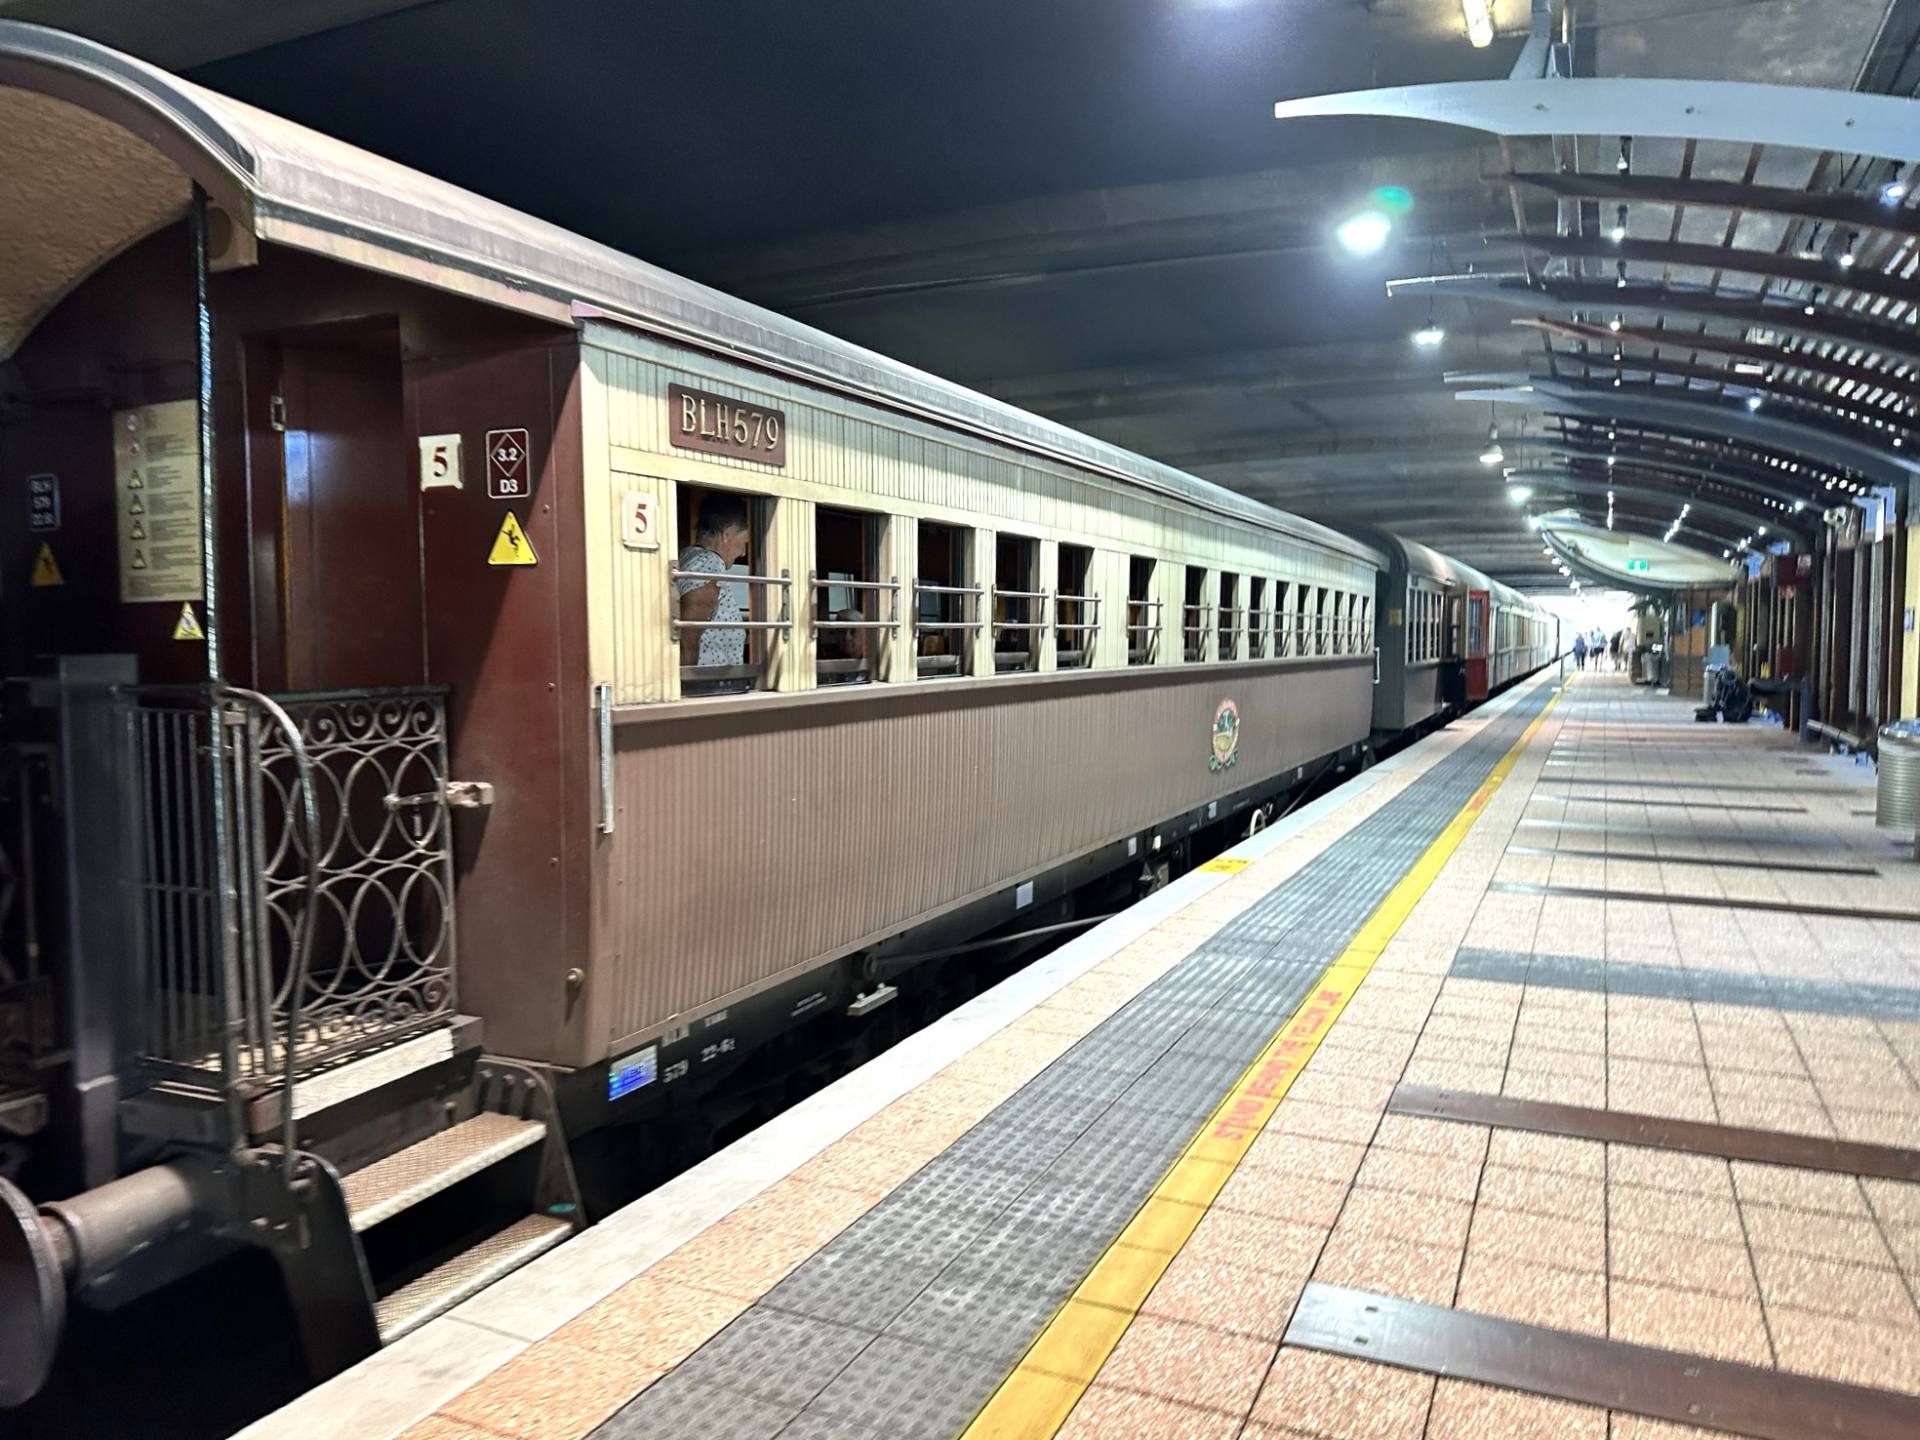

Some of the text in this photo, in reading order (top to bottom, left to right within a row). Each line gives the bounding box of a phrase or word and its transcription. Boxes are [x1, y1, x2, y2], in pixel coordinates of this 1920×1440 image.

[680, 393, 779, 450] BLH579
[433, 446, 448, 477] 5
[498, 447, 518, 462] 3.2
[500, 479, 519, 493] D3
[635, 503, 648, 533] 5
[1214, 1100, 1265, 1140] STAND
